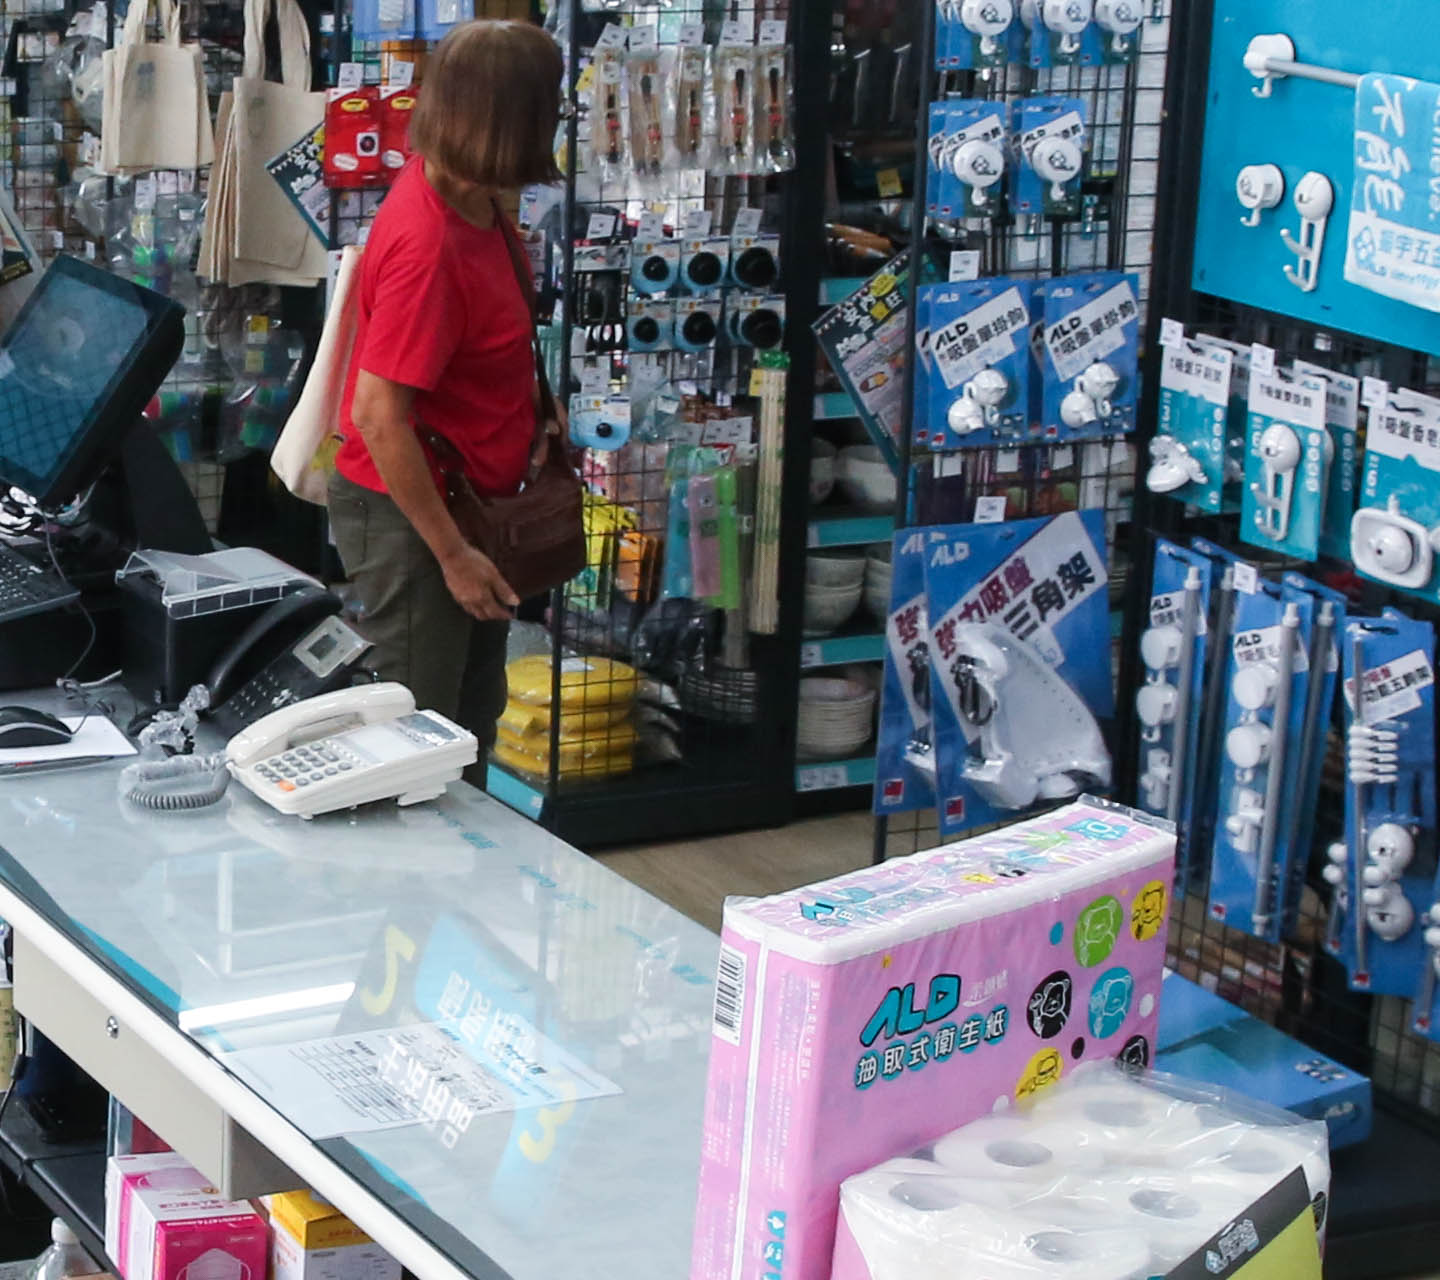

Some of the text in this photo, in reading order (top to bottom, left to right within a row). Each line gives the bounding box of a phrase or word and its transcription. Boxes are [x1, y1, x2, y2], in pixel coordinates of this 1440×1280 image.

[934, 321, 969, 351] ALD
[1049, 316, 1081, 344] ALD
[1003, 550, 1097, 642] 三角架
[855, 1005, 1009, 1090] 抽取式衛生紙
[858, 973, 963, 1048] ALD
